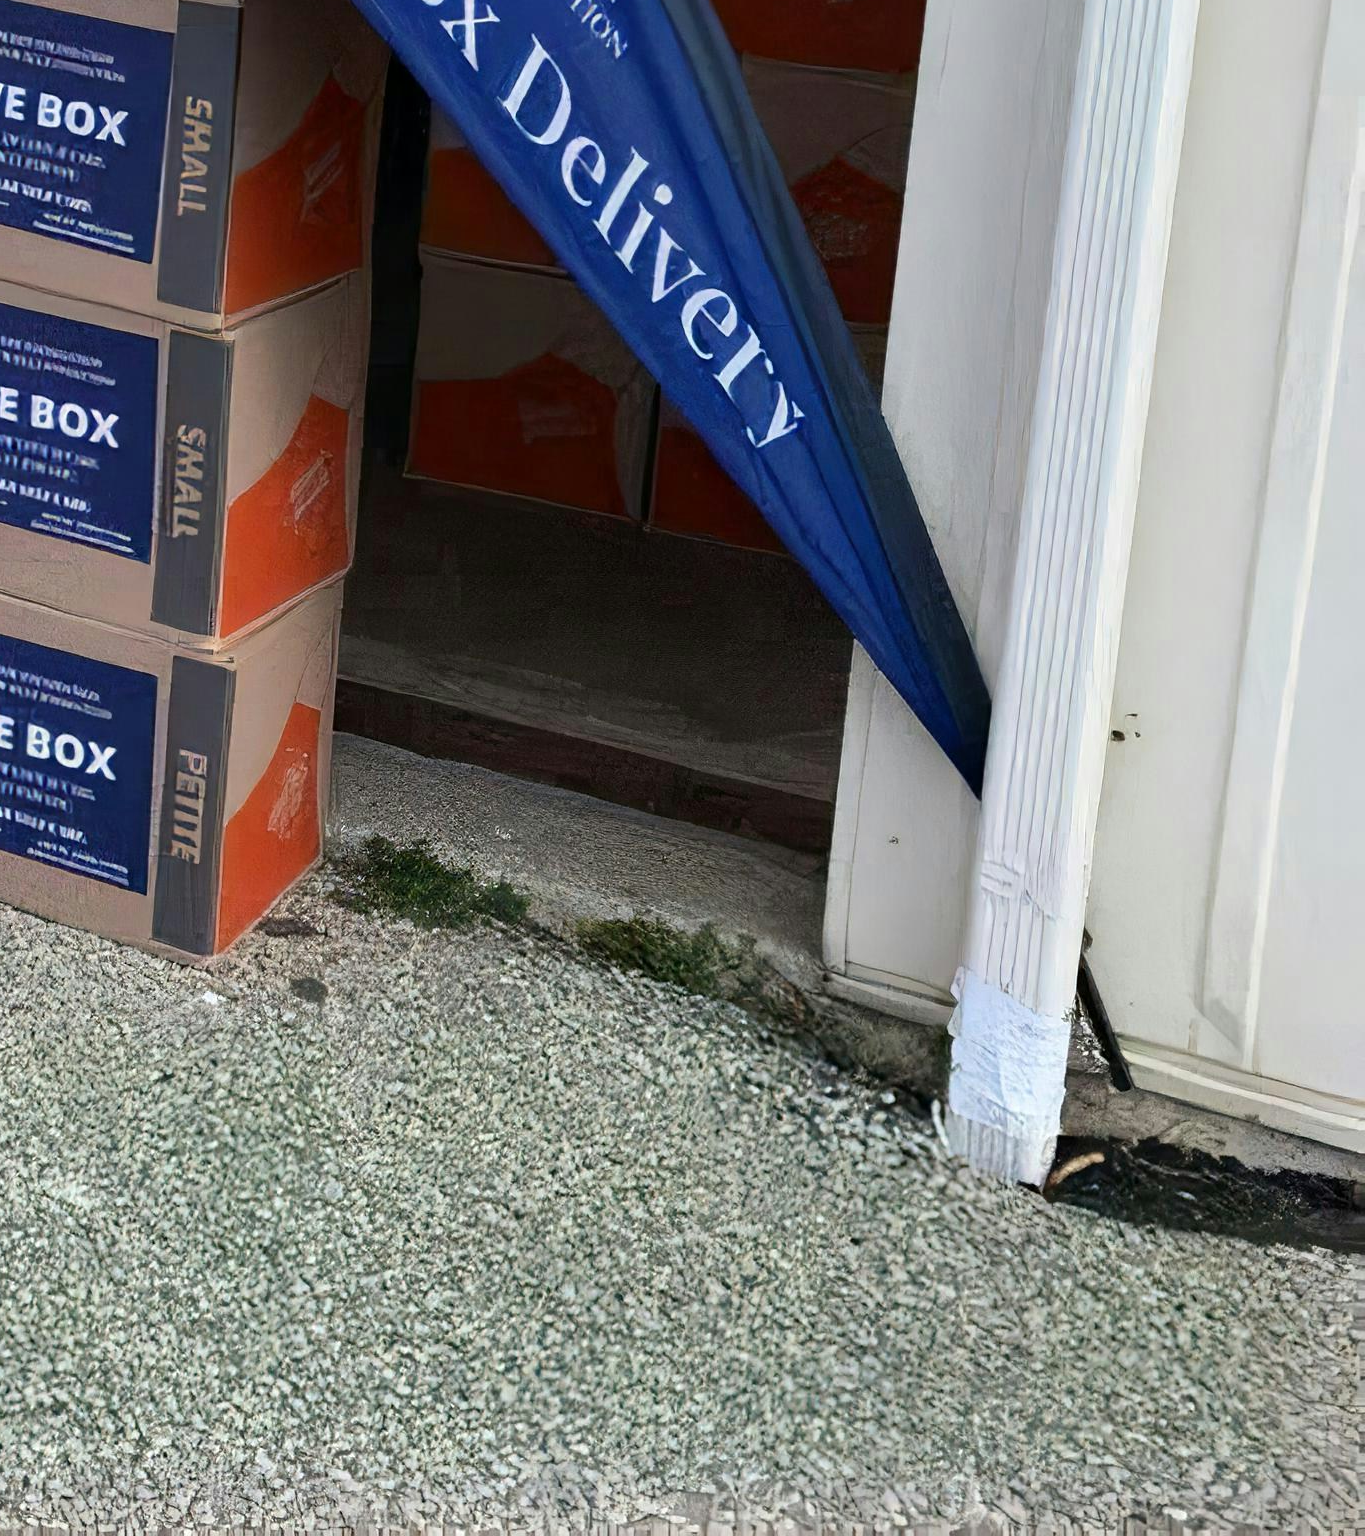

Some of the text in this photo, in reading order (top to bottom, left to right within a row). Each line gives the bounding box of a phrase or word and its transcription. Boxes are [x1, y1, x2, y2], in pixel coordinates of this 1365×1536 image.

[37, 92, 129, 146] BOX
[177, 95, 213, 217] SMALL
[497, 33, 806, 449] Delivery
[30, 394, 119, 448] BOX
[172, 424, 207, 538] SMALL
[26, 724, 117, 782] BOX
[171, 748, 208, 865] PETITE
